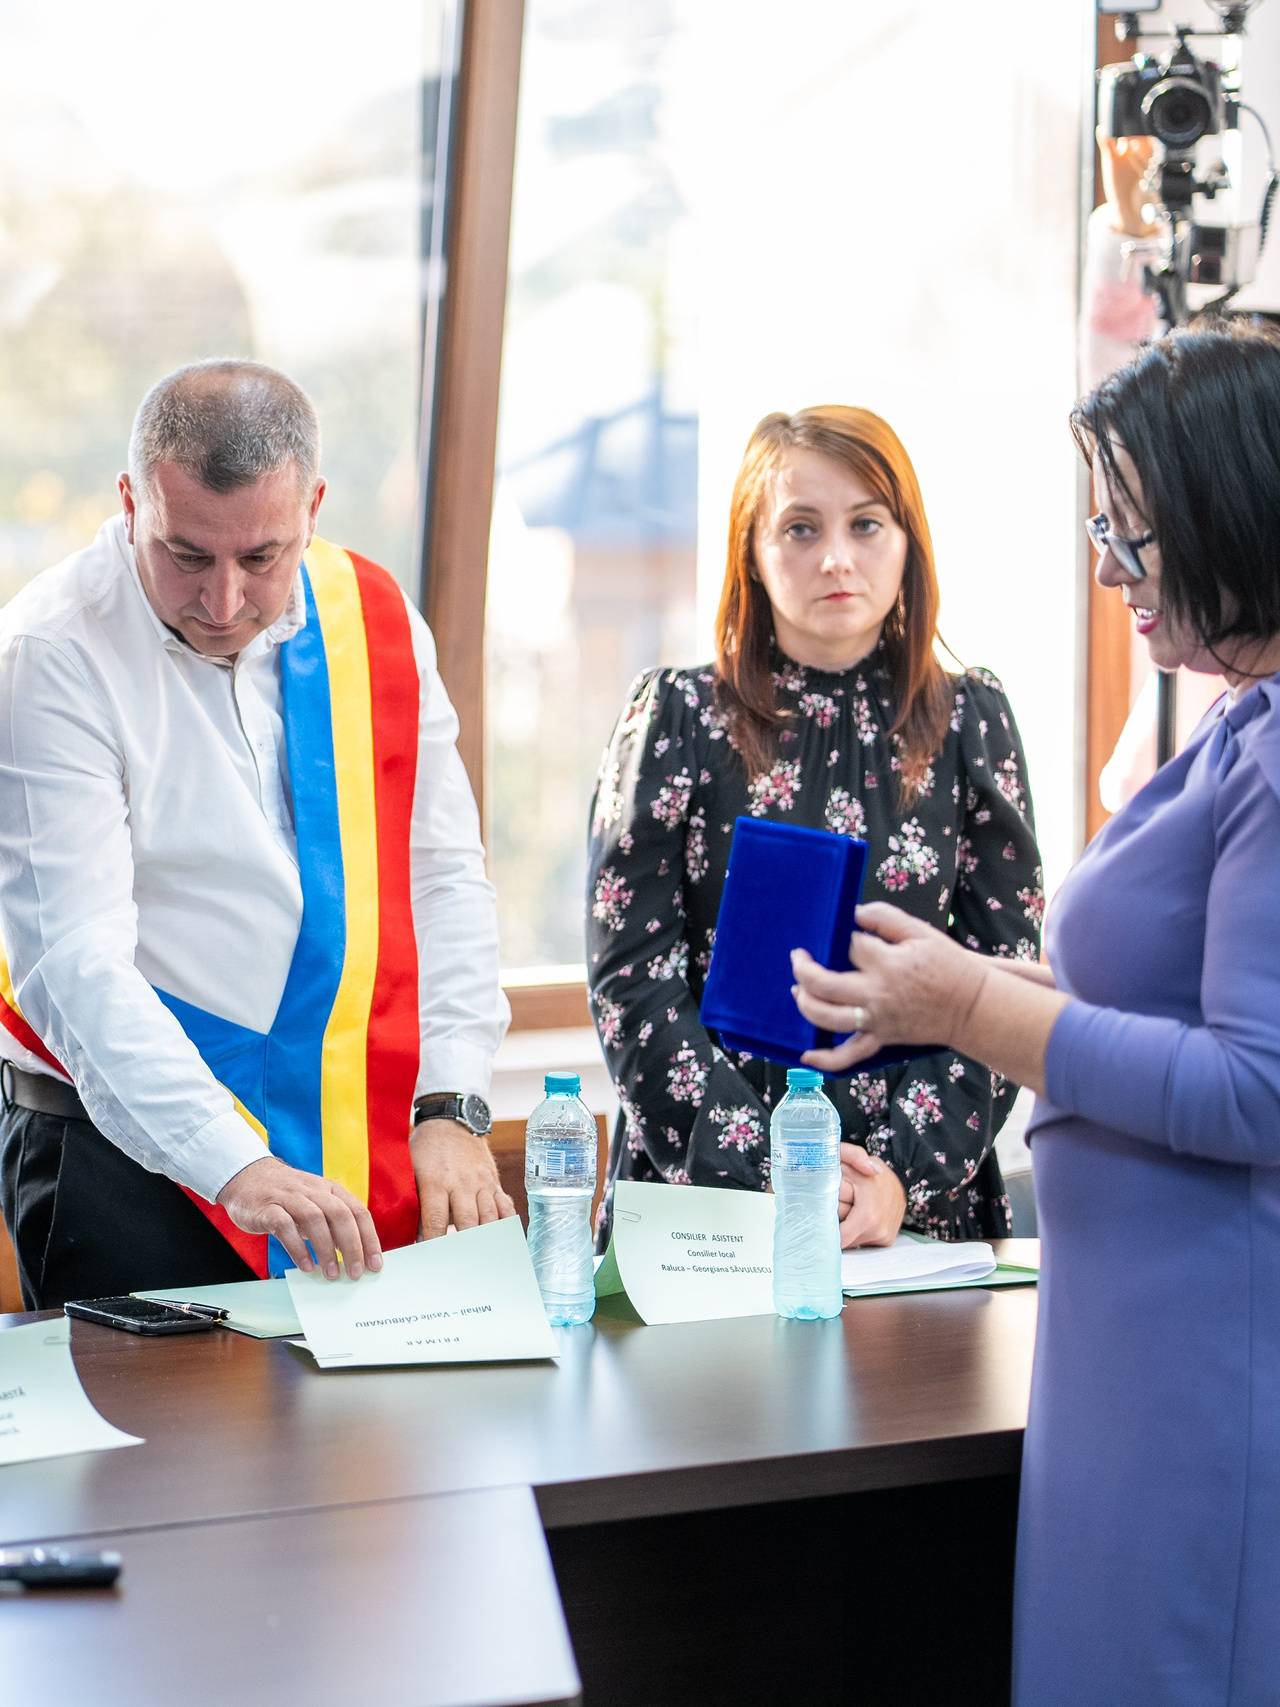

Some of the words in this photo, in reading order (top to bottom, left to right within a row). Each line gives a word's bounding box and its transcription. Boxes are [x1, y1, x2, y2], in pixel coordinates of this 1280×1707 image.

[670, 1231, 707, 1241] CONSILIER
[711, 1234, 744, 1243] ASISTENT
[686, 1249, 717, 1258] Consilier
[718, 1250, 736, 1258] local
[661, 1264, 686, 1272] Raluca
[692, 1264, 729, 1275] Georgiana
[420, 1310, 451, 1321] Vasile
[460, 1304, 492, 1316] Mihail
[354, 1315, 419, 1328] CĂRBUNARU
